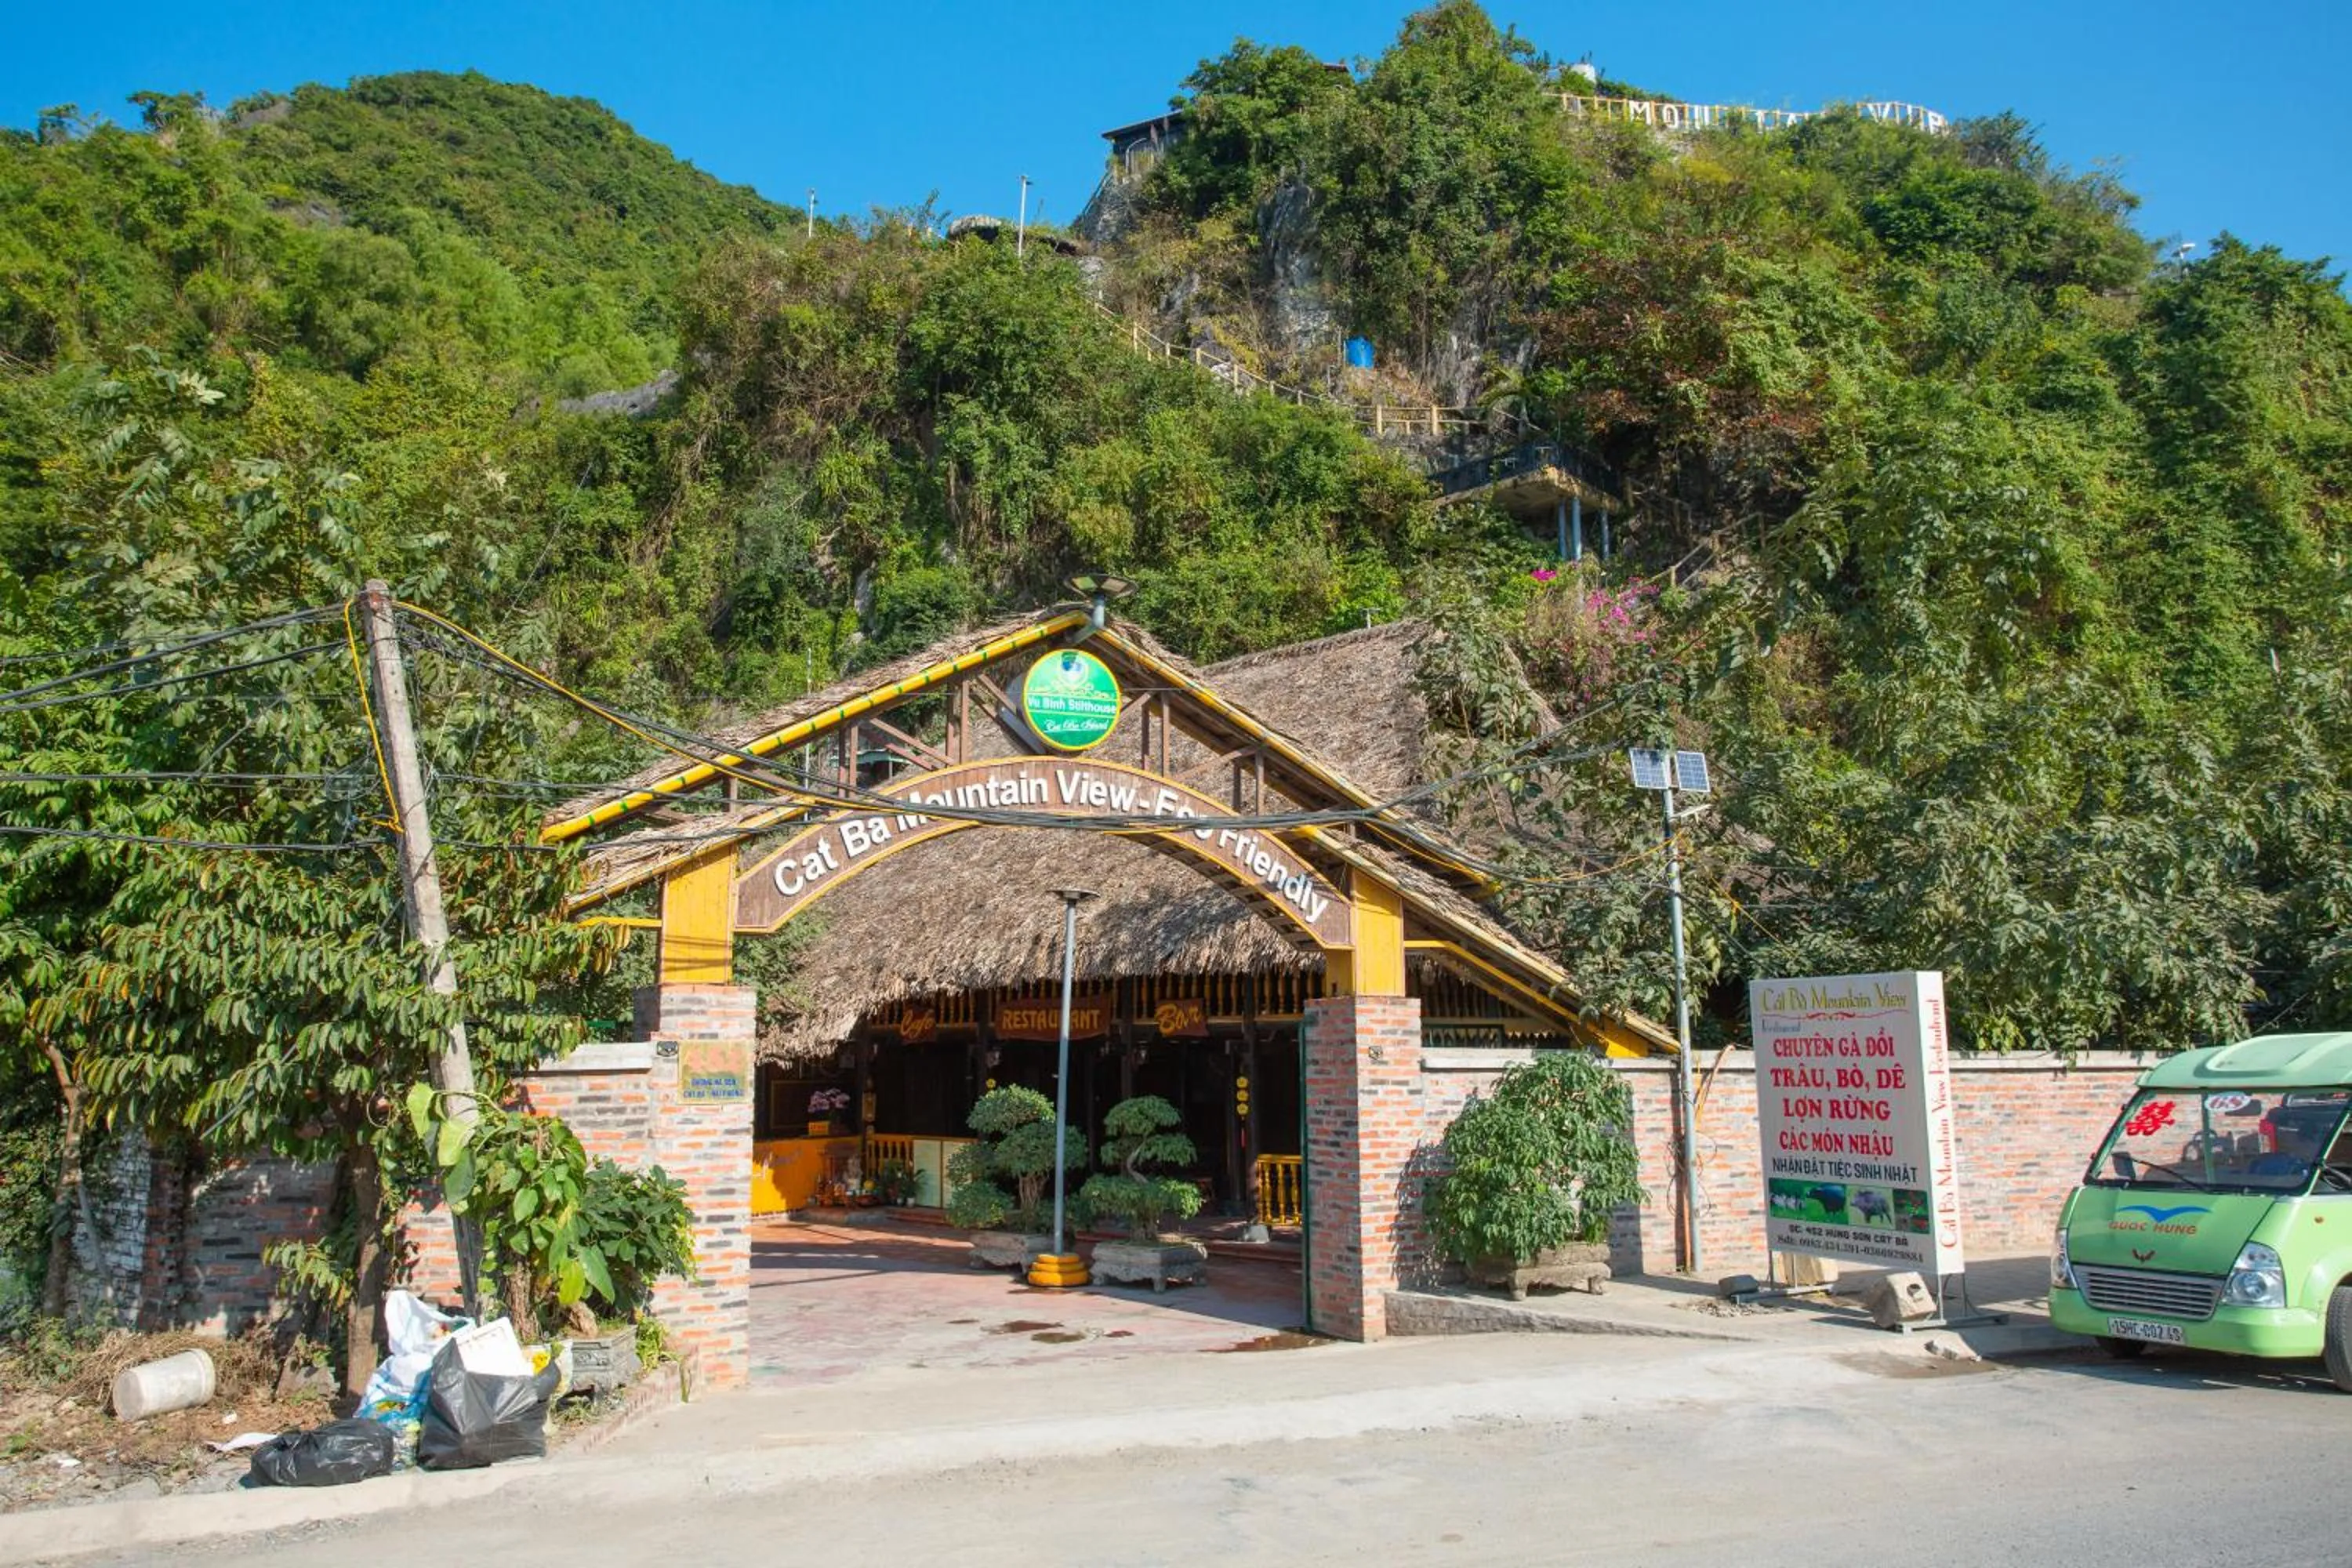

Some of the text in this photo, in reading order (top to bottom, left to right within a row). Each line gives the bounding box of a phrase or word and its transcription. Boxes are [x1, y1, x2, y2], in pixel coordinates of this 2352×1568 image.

[774, 837, 838, 896] Cat
[839, 816, 891, 858] Ba
[1218, 826, 1330, 923] Friendly
[1811, 984, 1872, 1010] Mountain
[1874, 981, 1907, 1009] View
[1001, 1008, 1102, 1032] RESTAUANT
[1773, 1033, 1834, 1058] CHUYÊN
[1876, 1062, 1907, 1089] DÊ
[1783, 1094, 1892, 1123] LỢN RỪNG
[1931, 1080, 1948, 1113] View
[1812, 1127, 1844, 1153] MÓN
[1849, 1129, 1894, 1161] NHẬU
[1854, 1162, 1882, 1181] SINH
